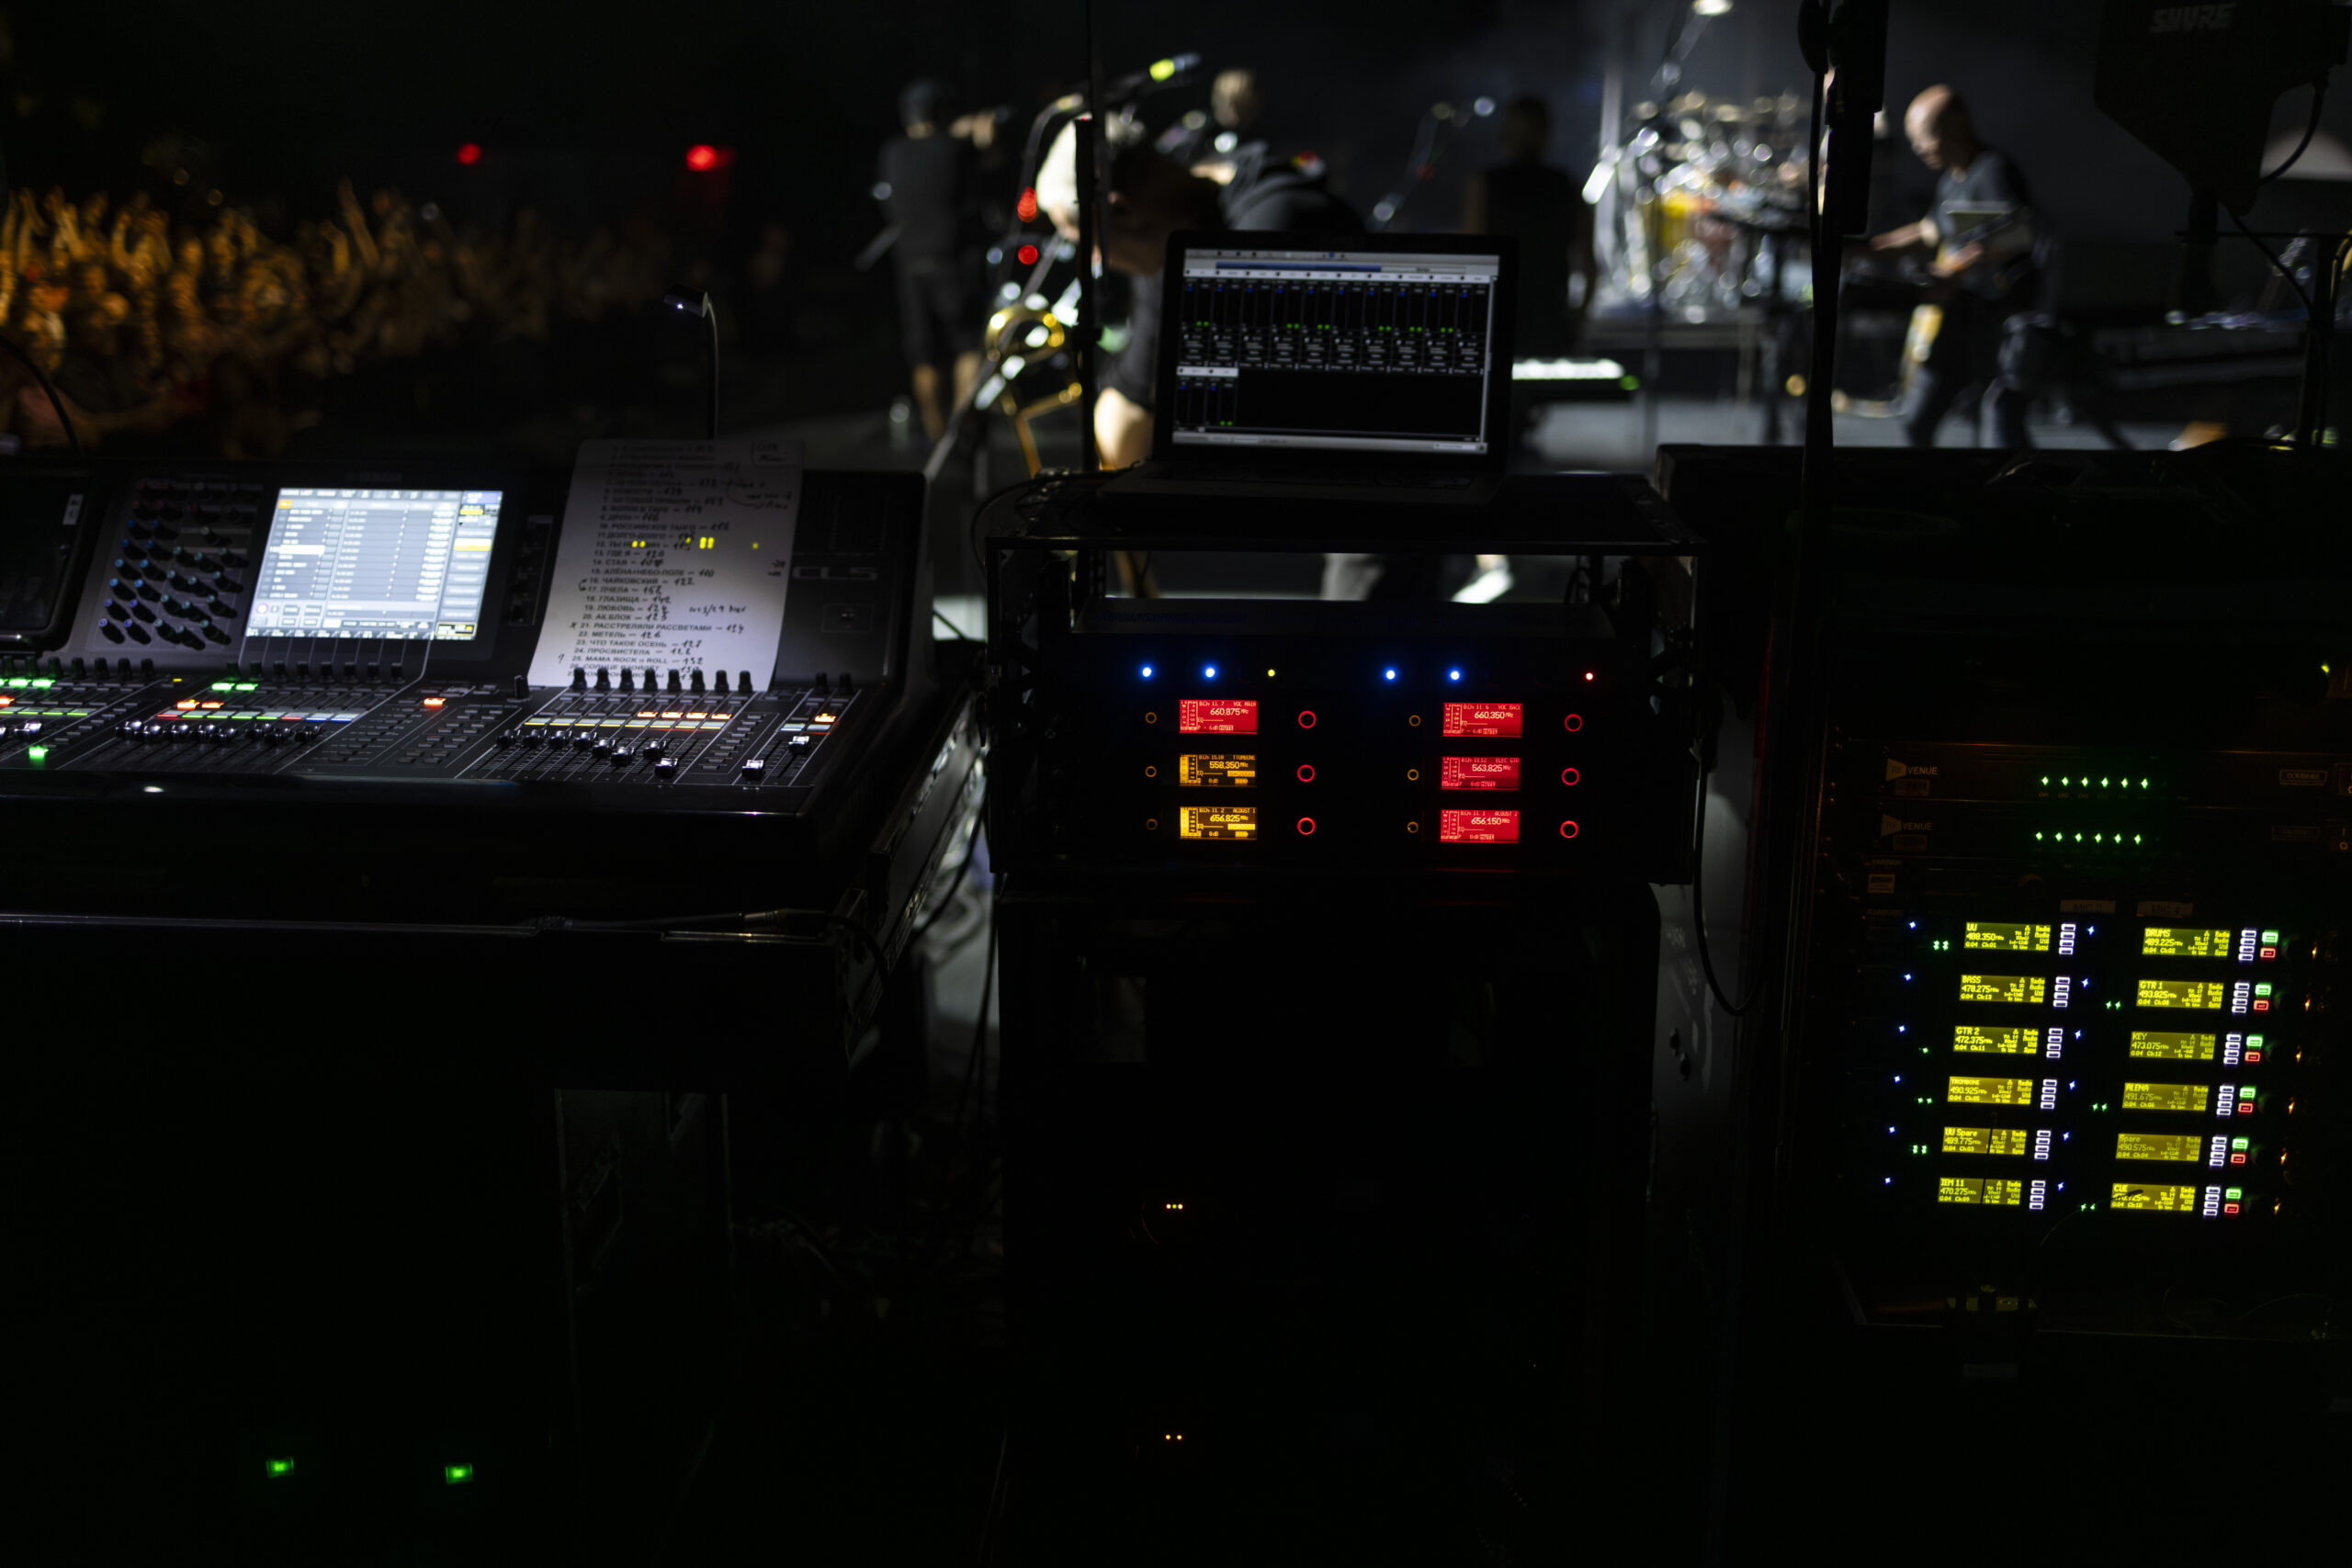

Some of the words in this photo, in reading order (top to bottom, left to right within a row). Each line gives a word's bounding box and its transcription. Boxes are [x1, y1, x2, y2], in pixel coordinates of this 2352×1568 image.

[2151, 4, 2235, 33] SHURE
[638, 640, 667, 649] ОСЕНЬ
[587, 648, 650, 656] ПРОСВИСТЕЛА
[2145, 929, 2171, 937] DRUMS
[1962, 976, 1982, 984] BASS
[2140, 981, 2156, 989] GTR
[1956, 1027, 1973, 1035] GTR
[2125, 1083, 2149, 1091] ALENA
[1956, 1129, 1978, 1137] Spare
[2119, 1134, 2141, 1144] Spare
[1940, 1179, 1954, 1187] IEM
[2113, 1184, 2128, 1192] CUE
